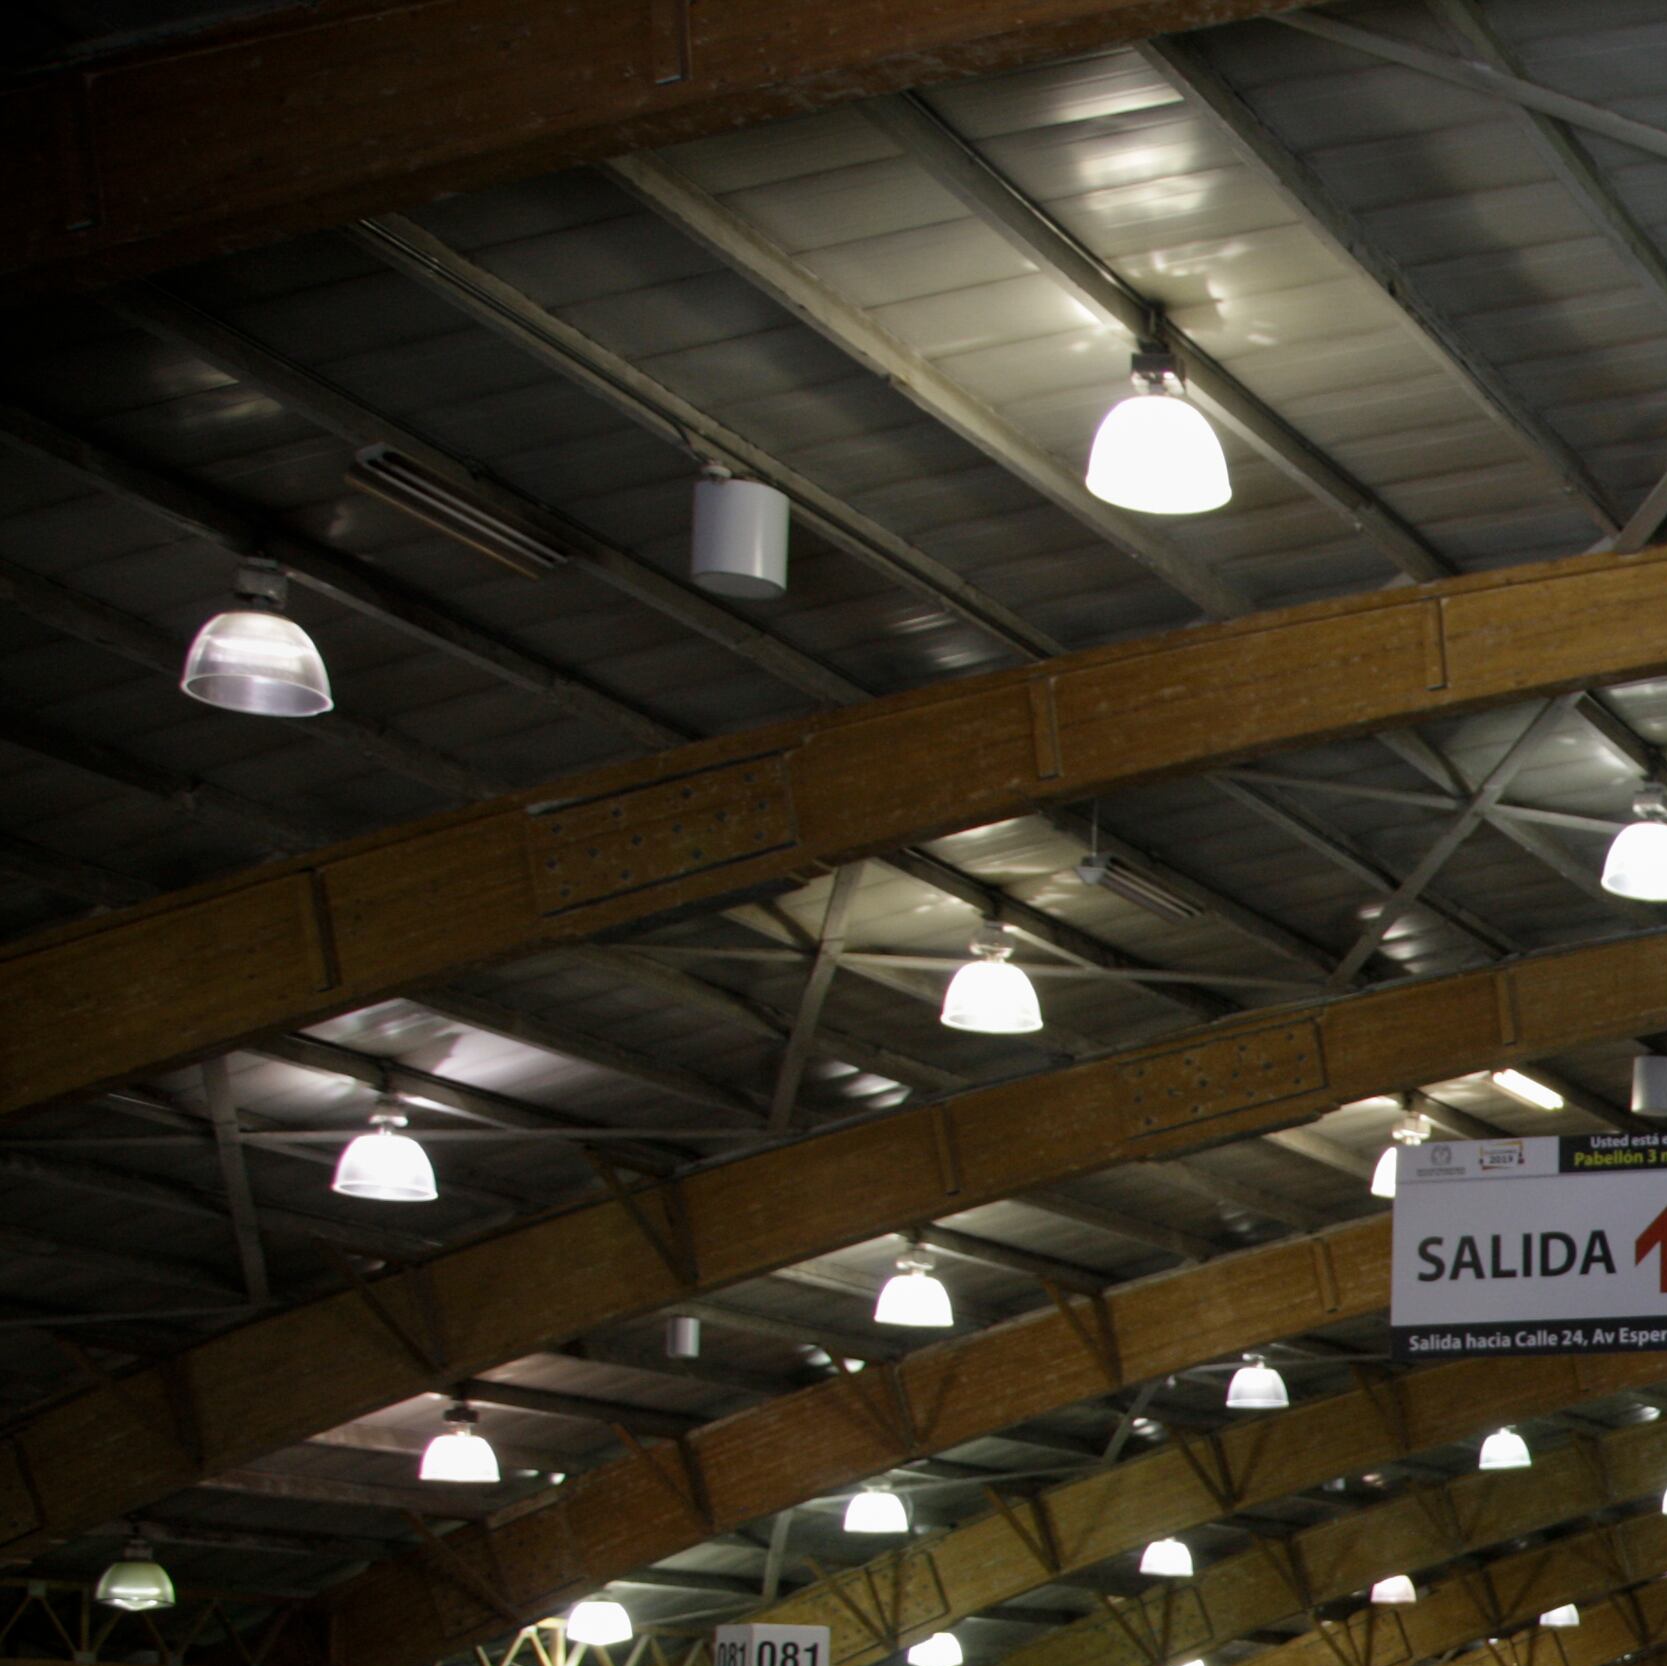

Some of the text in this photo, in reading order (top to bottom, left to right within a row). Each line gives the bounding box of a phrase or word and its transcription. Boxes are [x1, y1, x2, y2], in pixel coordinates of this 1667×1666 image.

[1590, 1135, 1629, 1149] Usted
[1631, 1132, 1660, 1147] está
[1574, 1150, 1645, 1167] Pabellón
[1647, 1149, 1657, 1162] 3
[1417, 1230, 1616, 1282] SALIDA
[1408, 1334, 1462, 1351] Salida
[1465, 1332, 1511, 1349] hacia
[1514, 1331, 1559, 1347] Calle
[1561, 1329, 1588, 1347] 24,
[1592, 1328, 1615, 1345] Av
